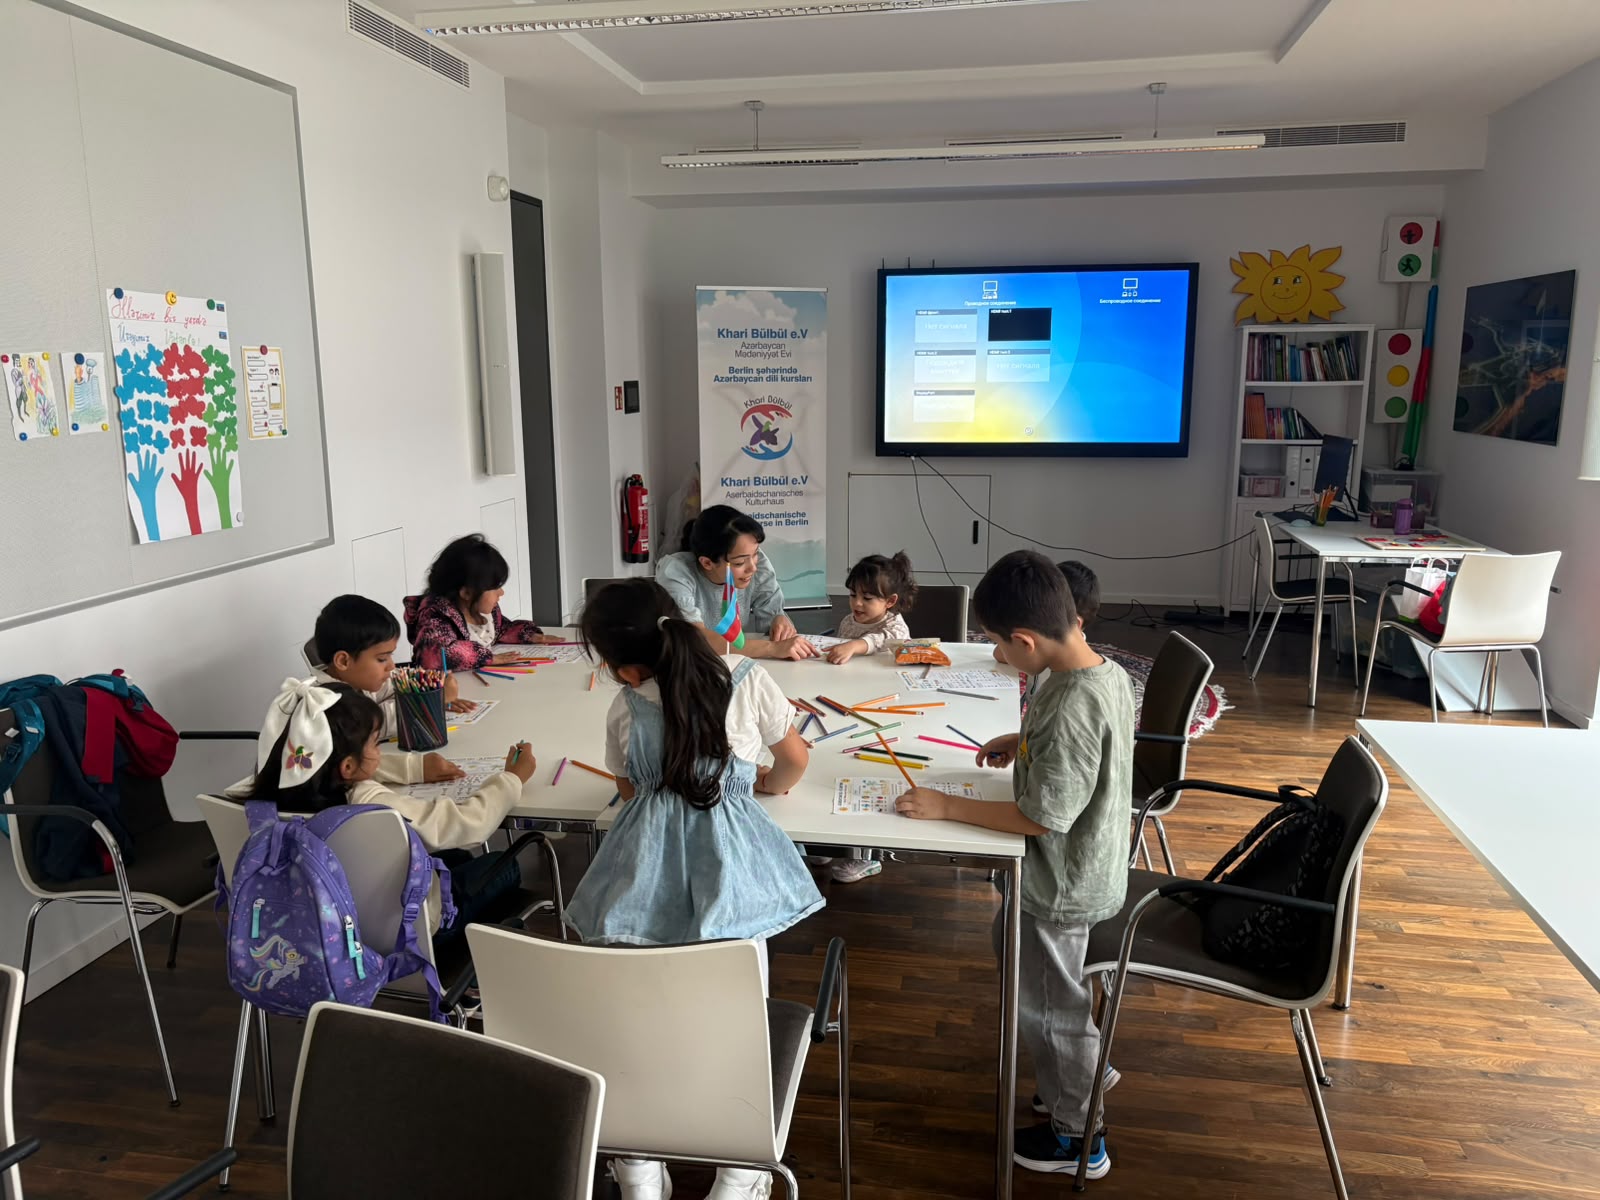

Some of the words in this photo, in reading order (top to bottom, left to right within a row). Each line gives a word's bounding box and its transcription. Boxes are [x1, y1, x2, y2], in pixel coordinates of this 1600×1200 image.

[717, 328, 748, 339] Khari
[751, 328, 787, 339] Bülbül
[790, 329, 808, 339] e.V
[740, 341, 786, 351] Azərbaycan
[734, 350, 779, 359] Mədəniyyət
[780, 350, 792, 358] Evi
[728, 366, 754, 375] Berlin
[756, 366, 798, 376] şəhərində
[713, 375, 763, 384] Azərbaycan
[766, 374, 778, 382] dili
[781, 374, 812, 383] kursları
[743, 396, 765, 409] Khari
[720, 476, 750, 487] Khari
[753, 475, 788, 486] Bülbül
[791, 475, 808, 485] e.V
[725, 489, 804, 499] Aserbaidschanisches
[745, 498, 784, 506] Kulturhaus
[775, 519, 783, 527] in
[785, 518, 809, 526] Berlin
